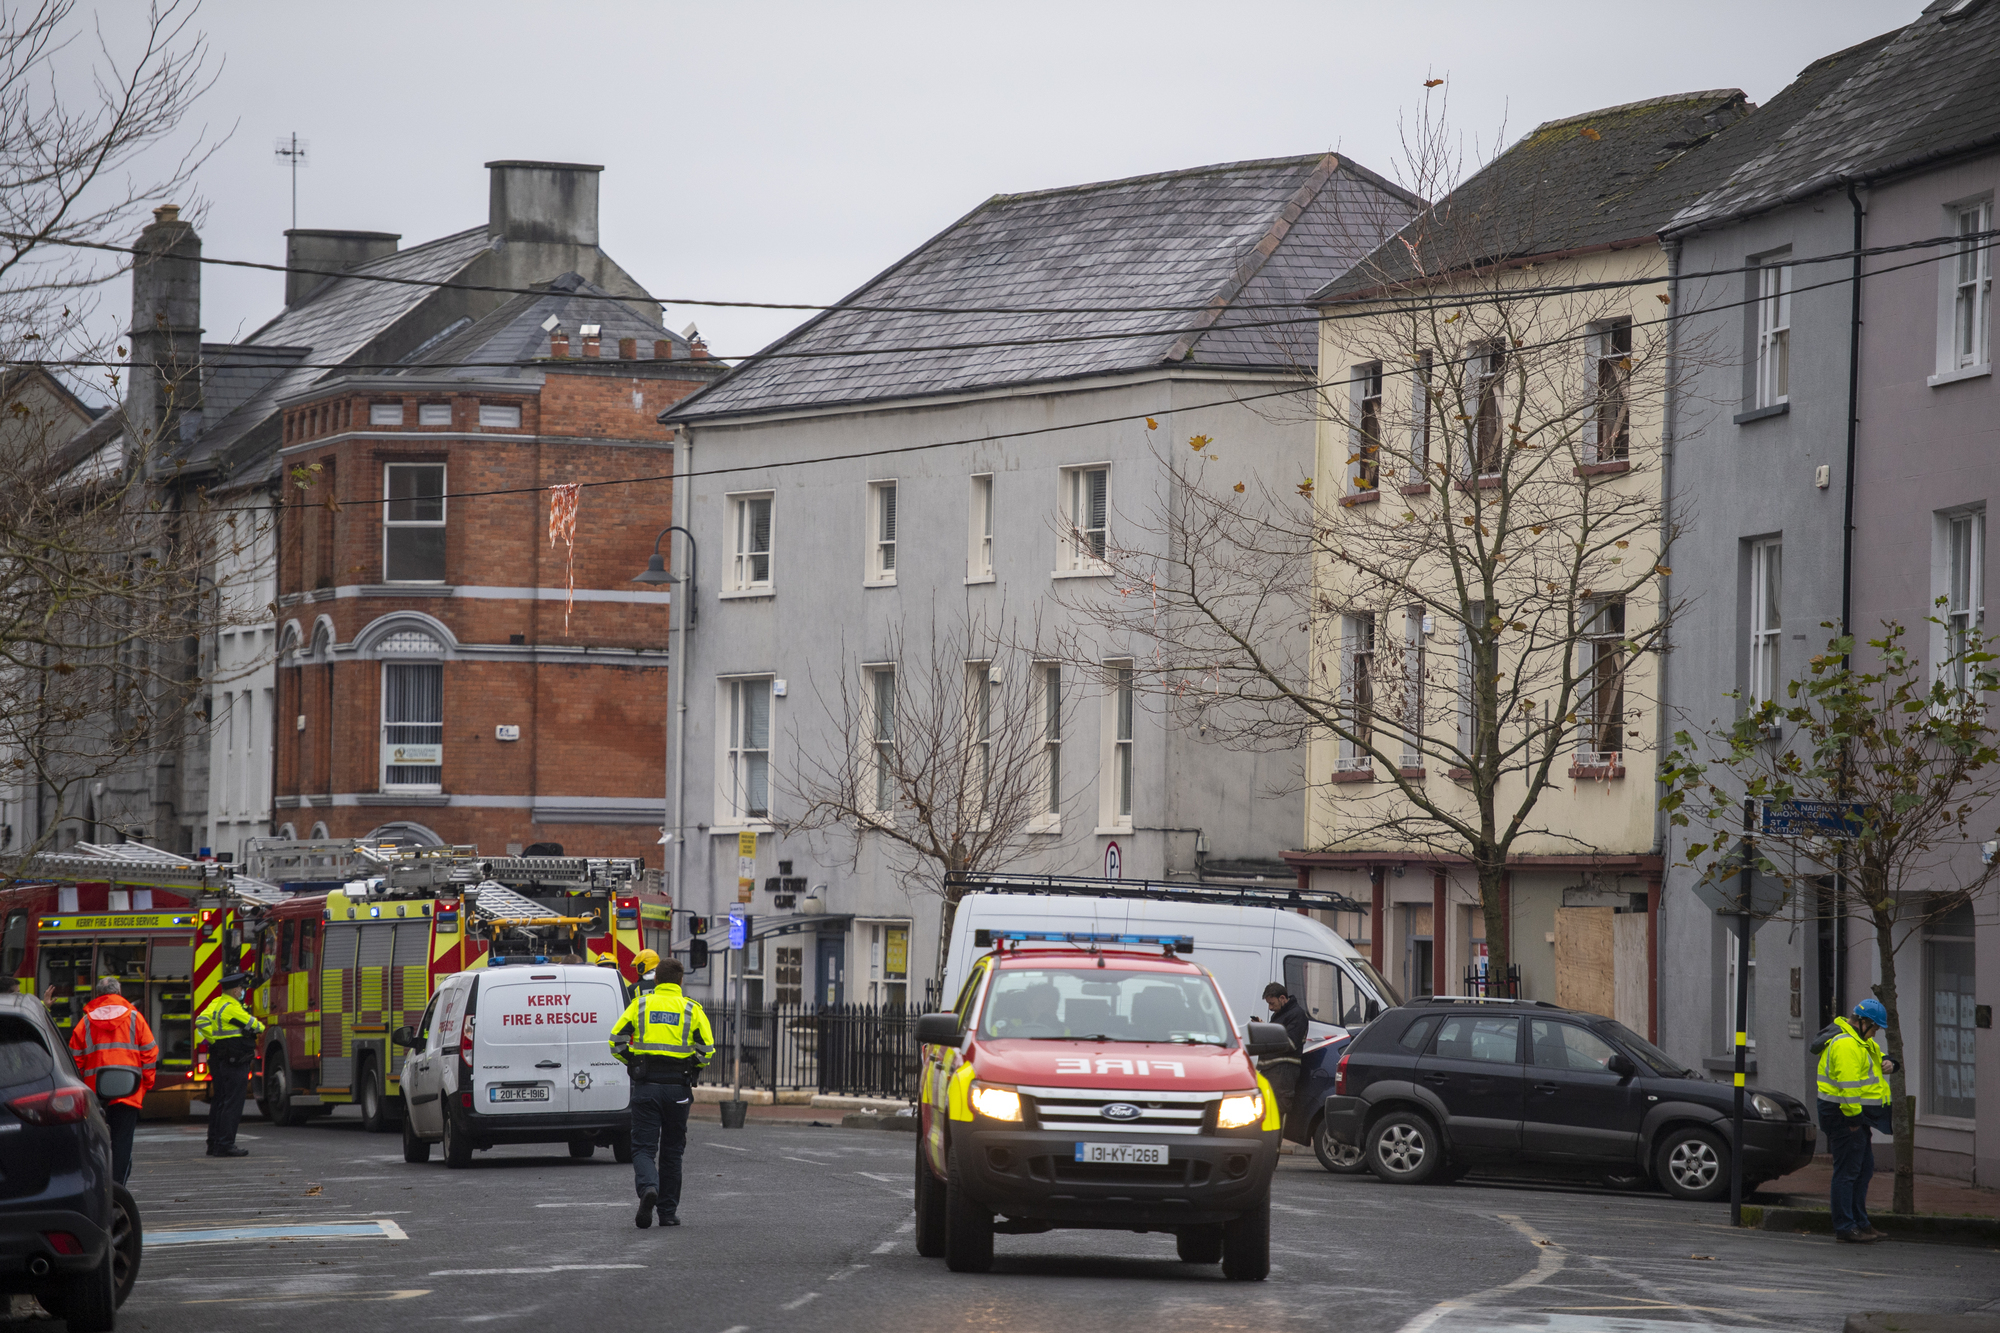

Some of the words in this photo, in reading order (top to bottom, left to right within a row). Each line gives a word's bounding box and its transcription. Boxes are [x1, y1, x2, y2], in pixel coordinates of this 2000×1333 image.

[1770, 819, 1783, 827] ST.
[1769, 826, 1813, 835] NATION
[1817, 828, 1855, 836] CHOOL
[76, 918, 94, 928] KERRY
[95, 917, 107, 927] FIRE
[113, 917, 135, 927] RESCUE
[136, 916, 159, 926] SERVICE
[527, 994, 572, 1007] KERRY
[503, 1013, 532, 1026] FIRE
[534, 1013, 544, 1025] &
[546, 1012, 598, 1025] RESCUE
[650, 1012, 679, 1024] GARDA
[500, 1089, 545, 1099] 201-KE-1916
[1109, 1105, 1133, 1116] Ford
[1091, 1147, 1159, 1162] 131-KY-1268
